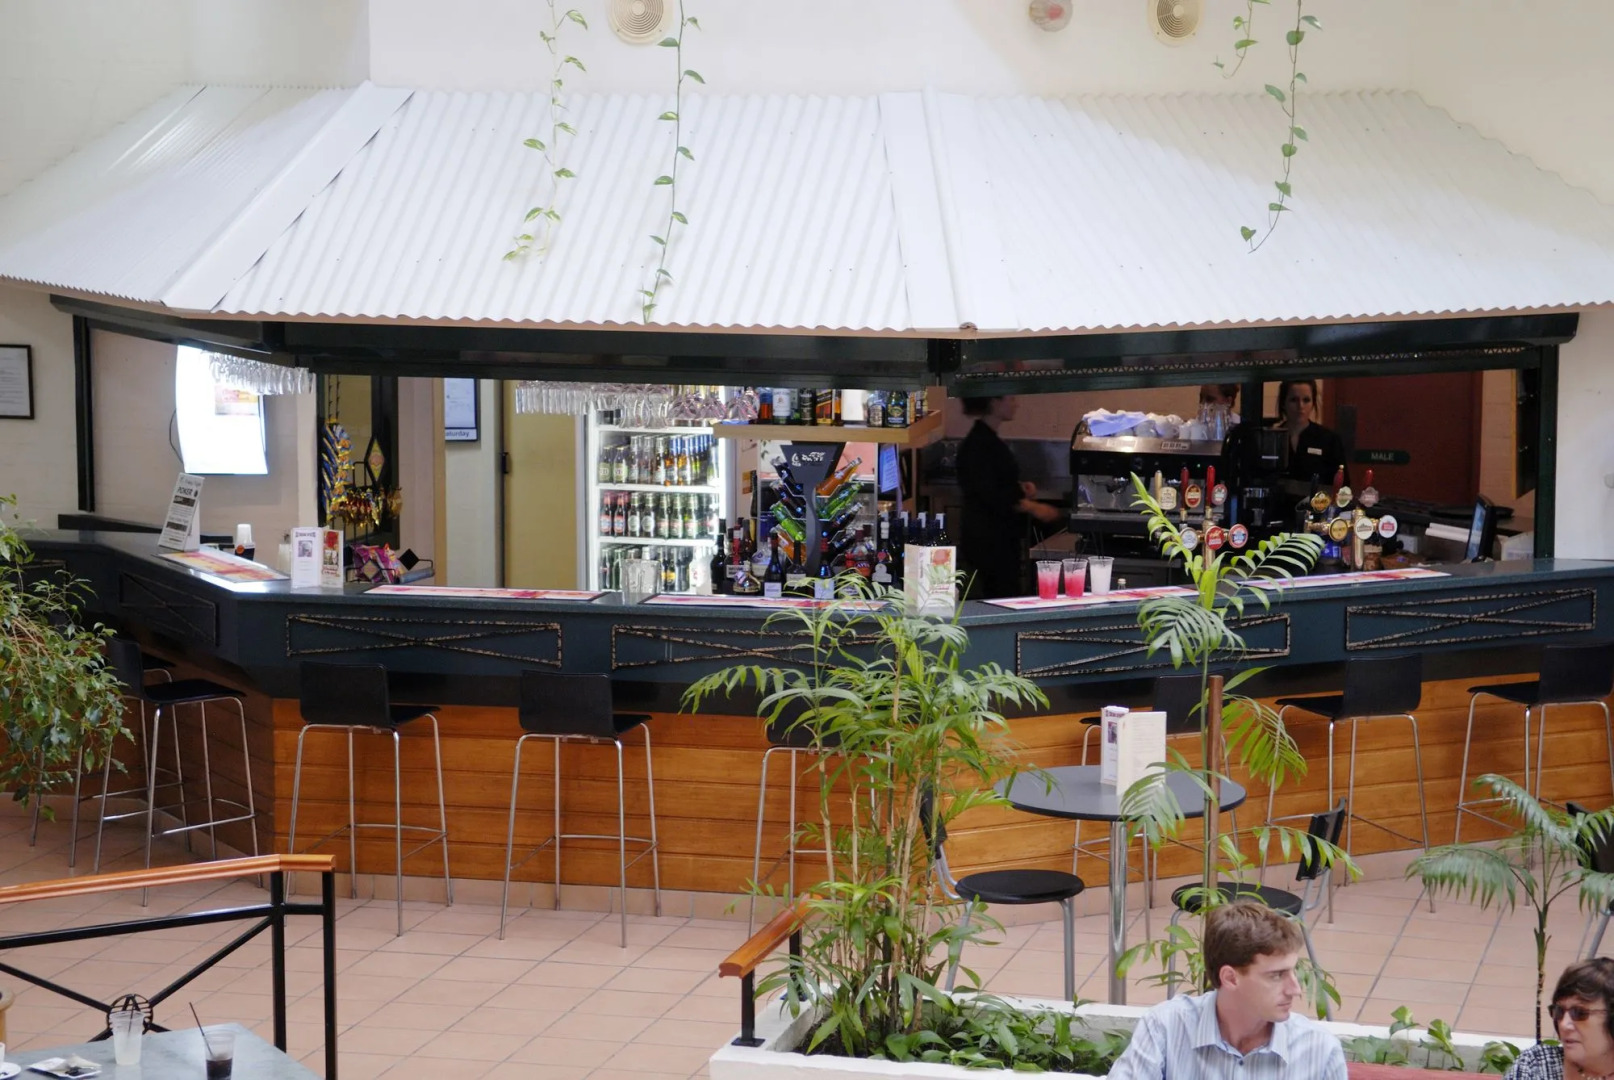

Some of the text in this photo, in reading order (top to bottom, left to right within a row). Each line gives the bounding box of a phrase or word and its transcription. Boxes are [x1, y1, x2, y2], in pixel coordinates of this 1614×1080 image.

[445, 430, 470, 438] aturday
[1370, 452, 1395, 461] MALE
[177, 486, 193, 496] POKER
